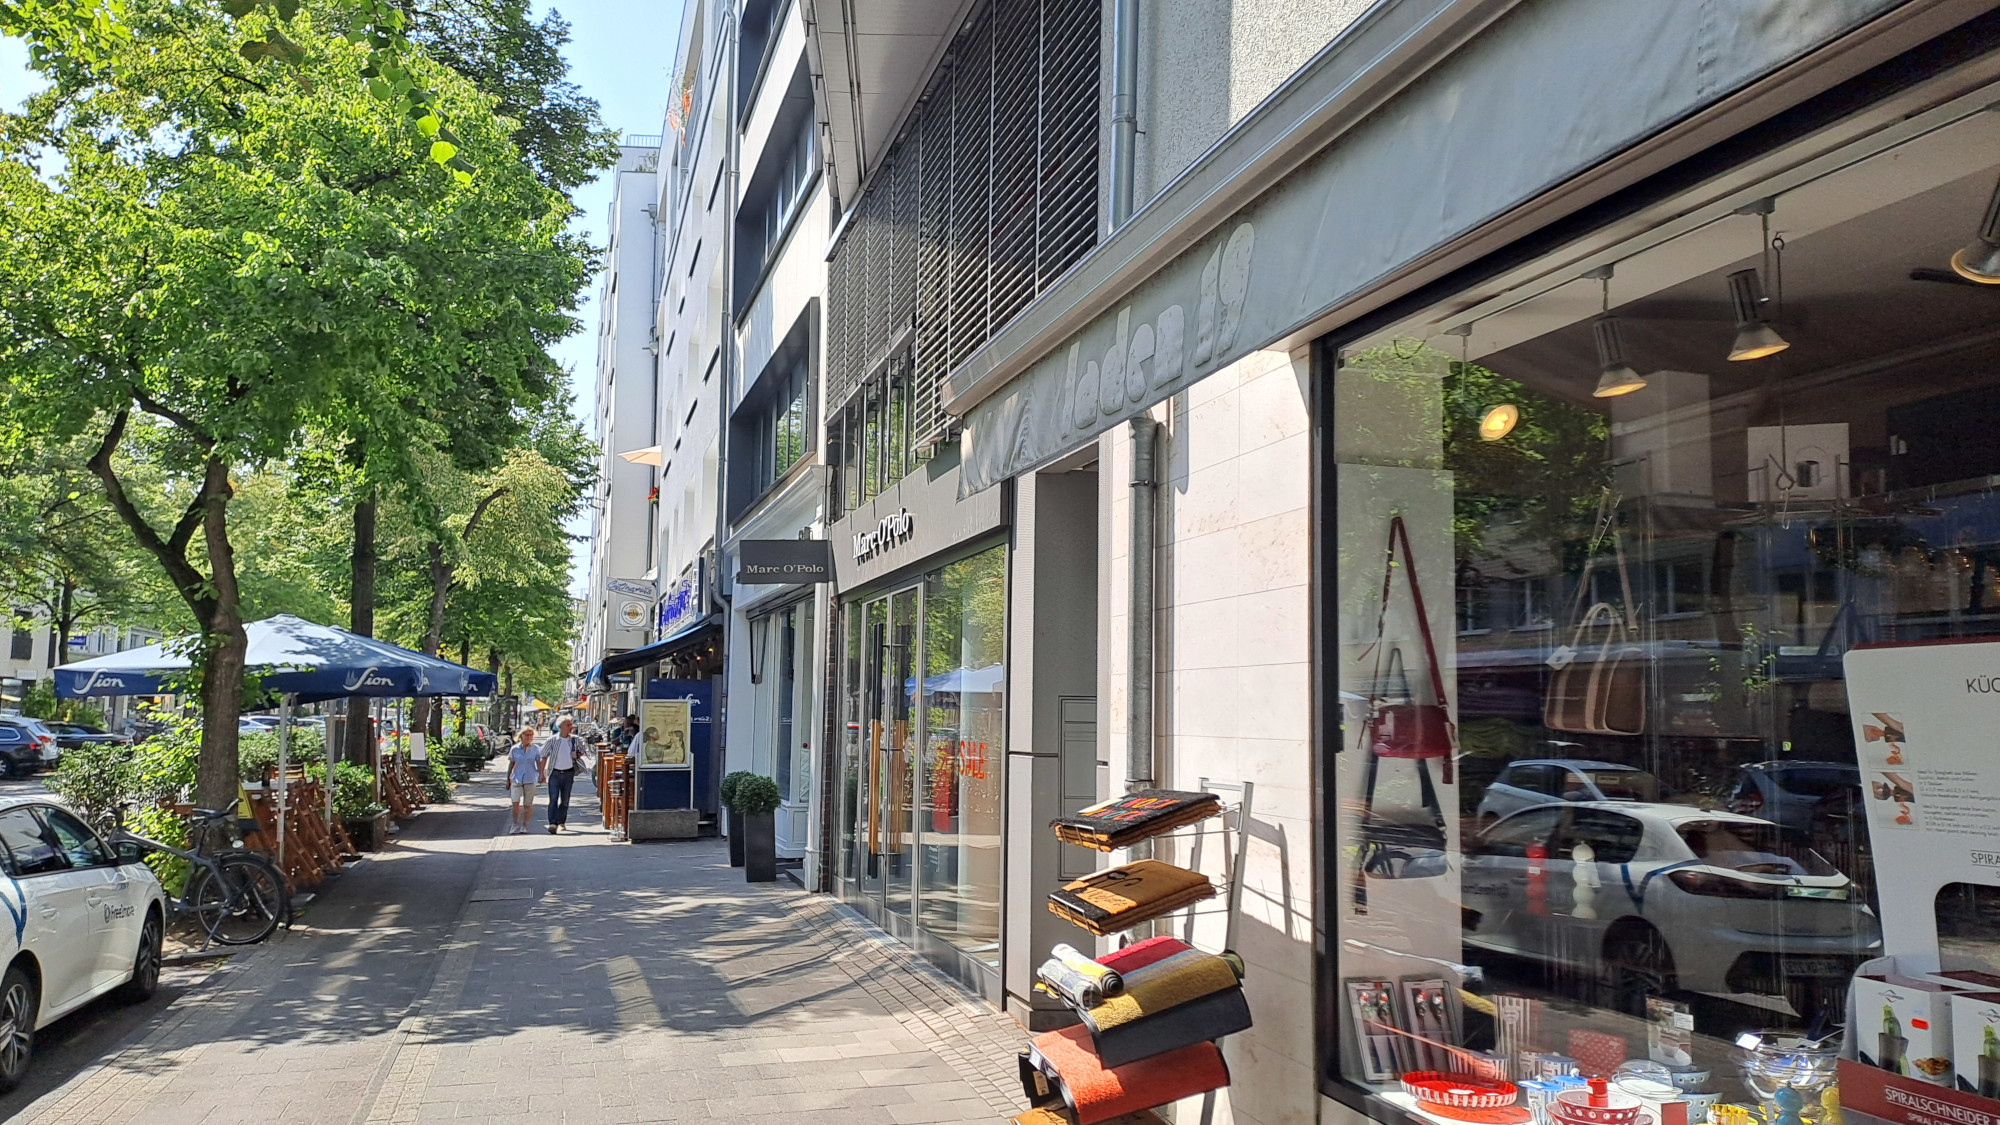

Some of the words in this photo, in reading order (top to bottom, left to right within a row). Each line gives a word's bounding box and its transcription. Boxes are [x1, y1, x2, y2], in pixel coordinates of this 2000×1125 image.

[852, 533, 876, 559] Marc
[877, 507, 910, 546] O'Polo
[746, 564, 780, 574] Marc
[783, 564, 824, 574] O'Polo
[72, 668, 125, 695] Sion
[342, 666, 395, 691] Sion
[959, 740, 986, 780] SALE
[1885, 1087, 1990, 1125] SPIRALSCHNEIDER
